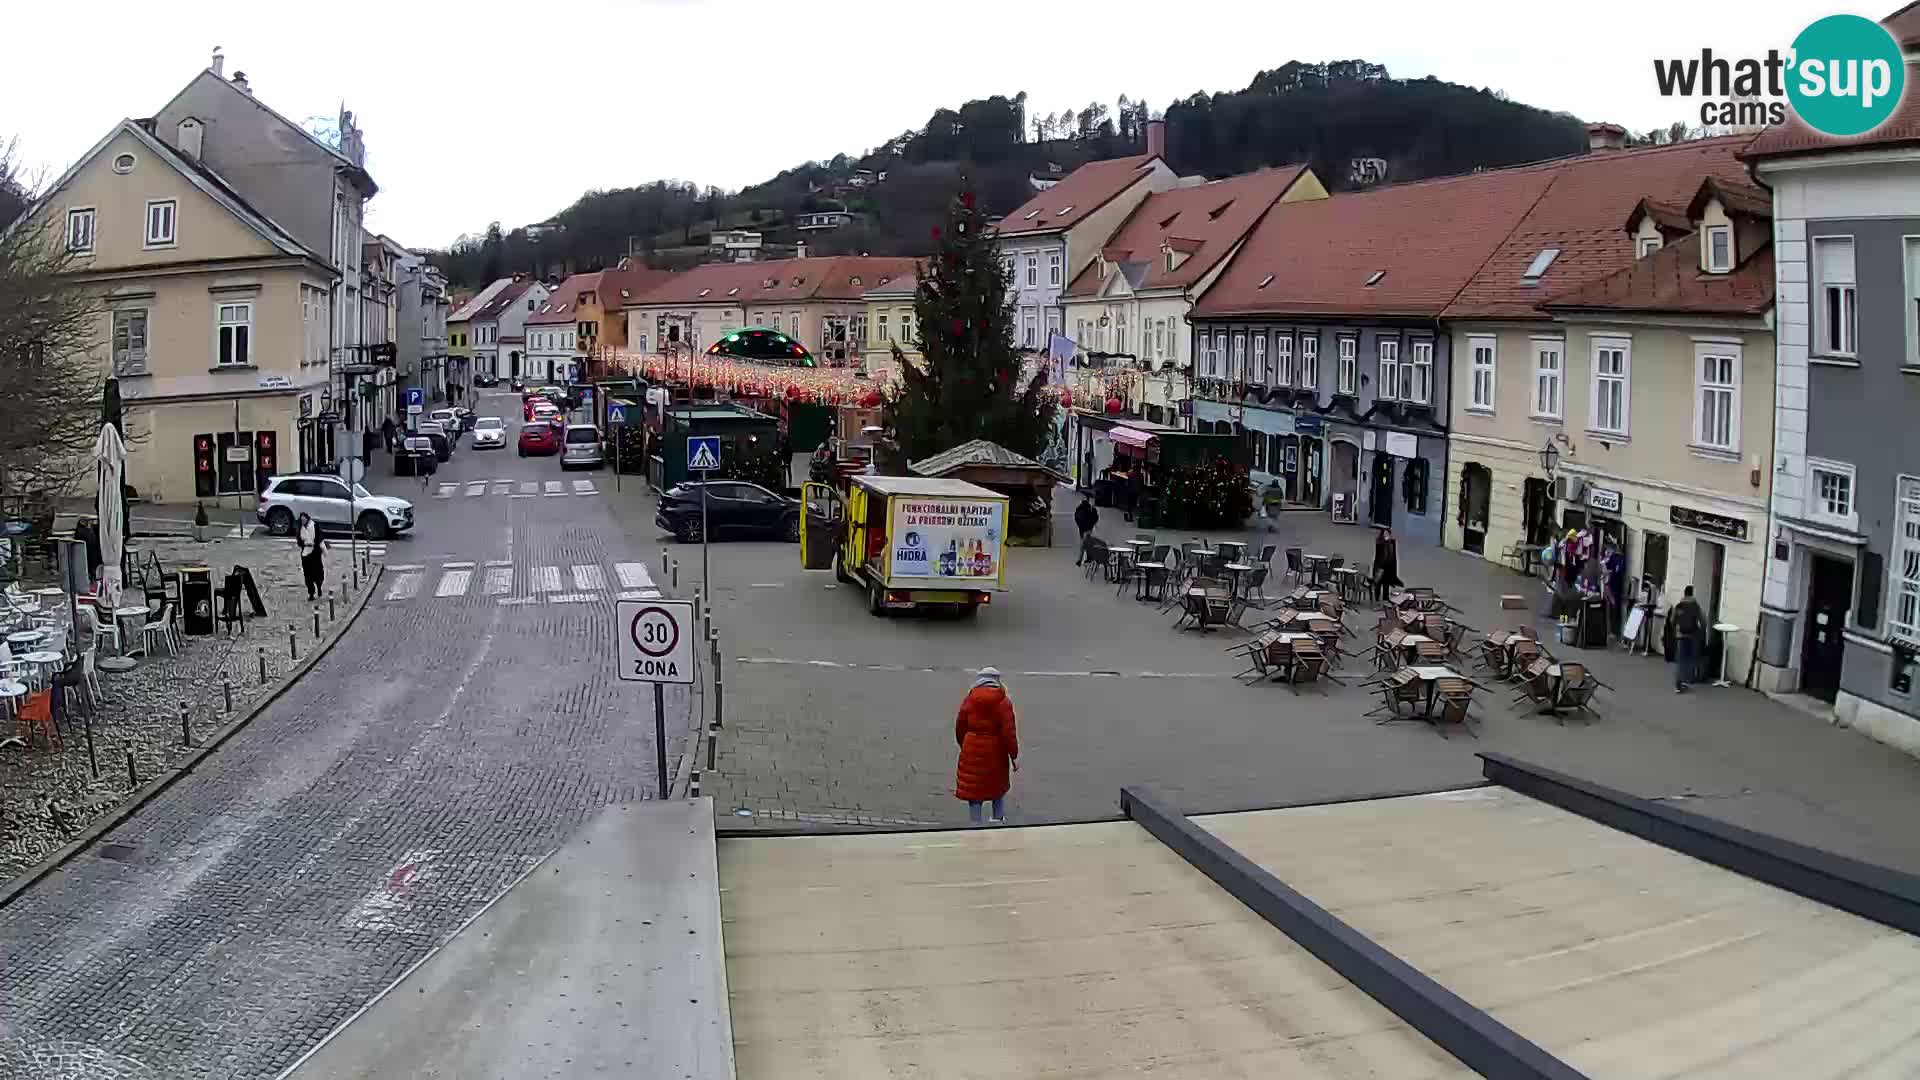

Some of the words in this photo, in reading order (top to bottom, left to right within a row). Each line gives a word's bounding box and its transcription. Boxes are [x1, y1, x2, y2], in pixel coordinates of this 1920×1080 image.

[907, 515, 916, 525] ZA
[897, 550, 928, 562] HIDRA
[644, 622, 668, 644] 30
[634, 659, 679, 677] ZONA
